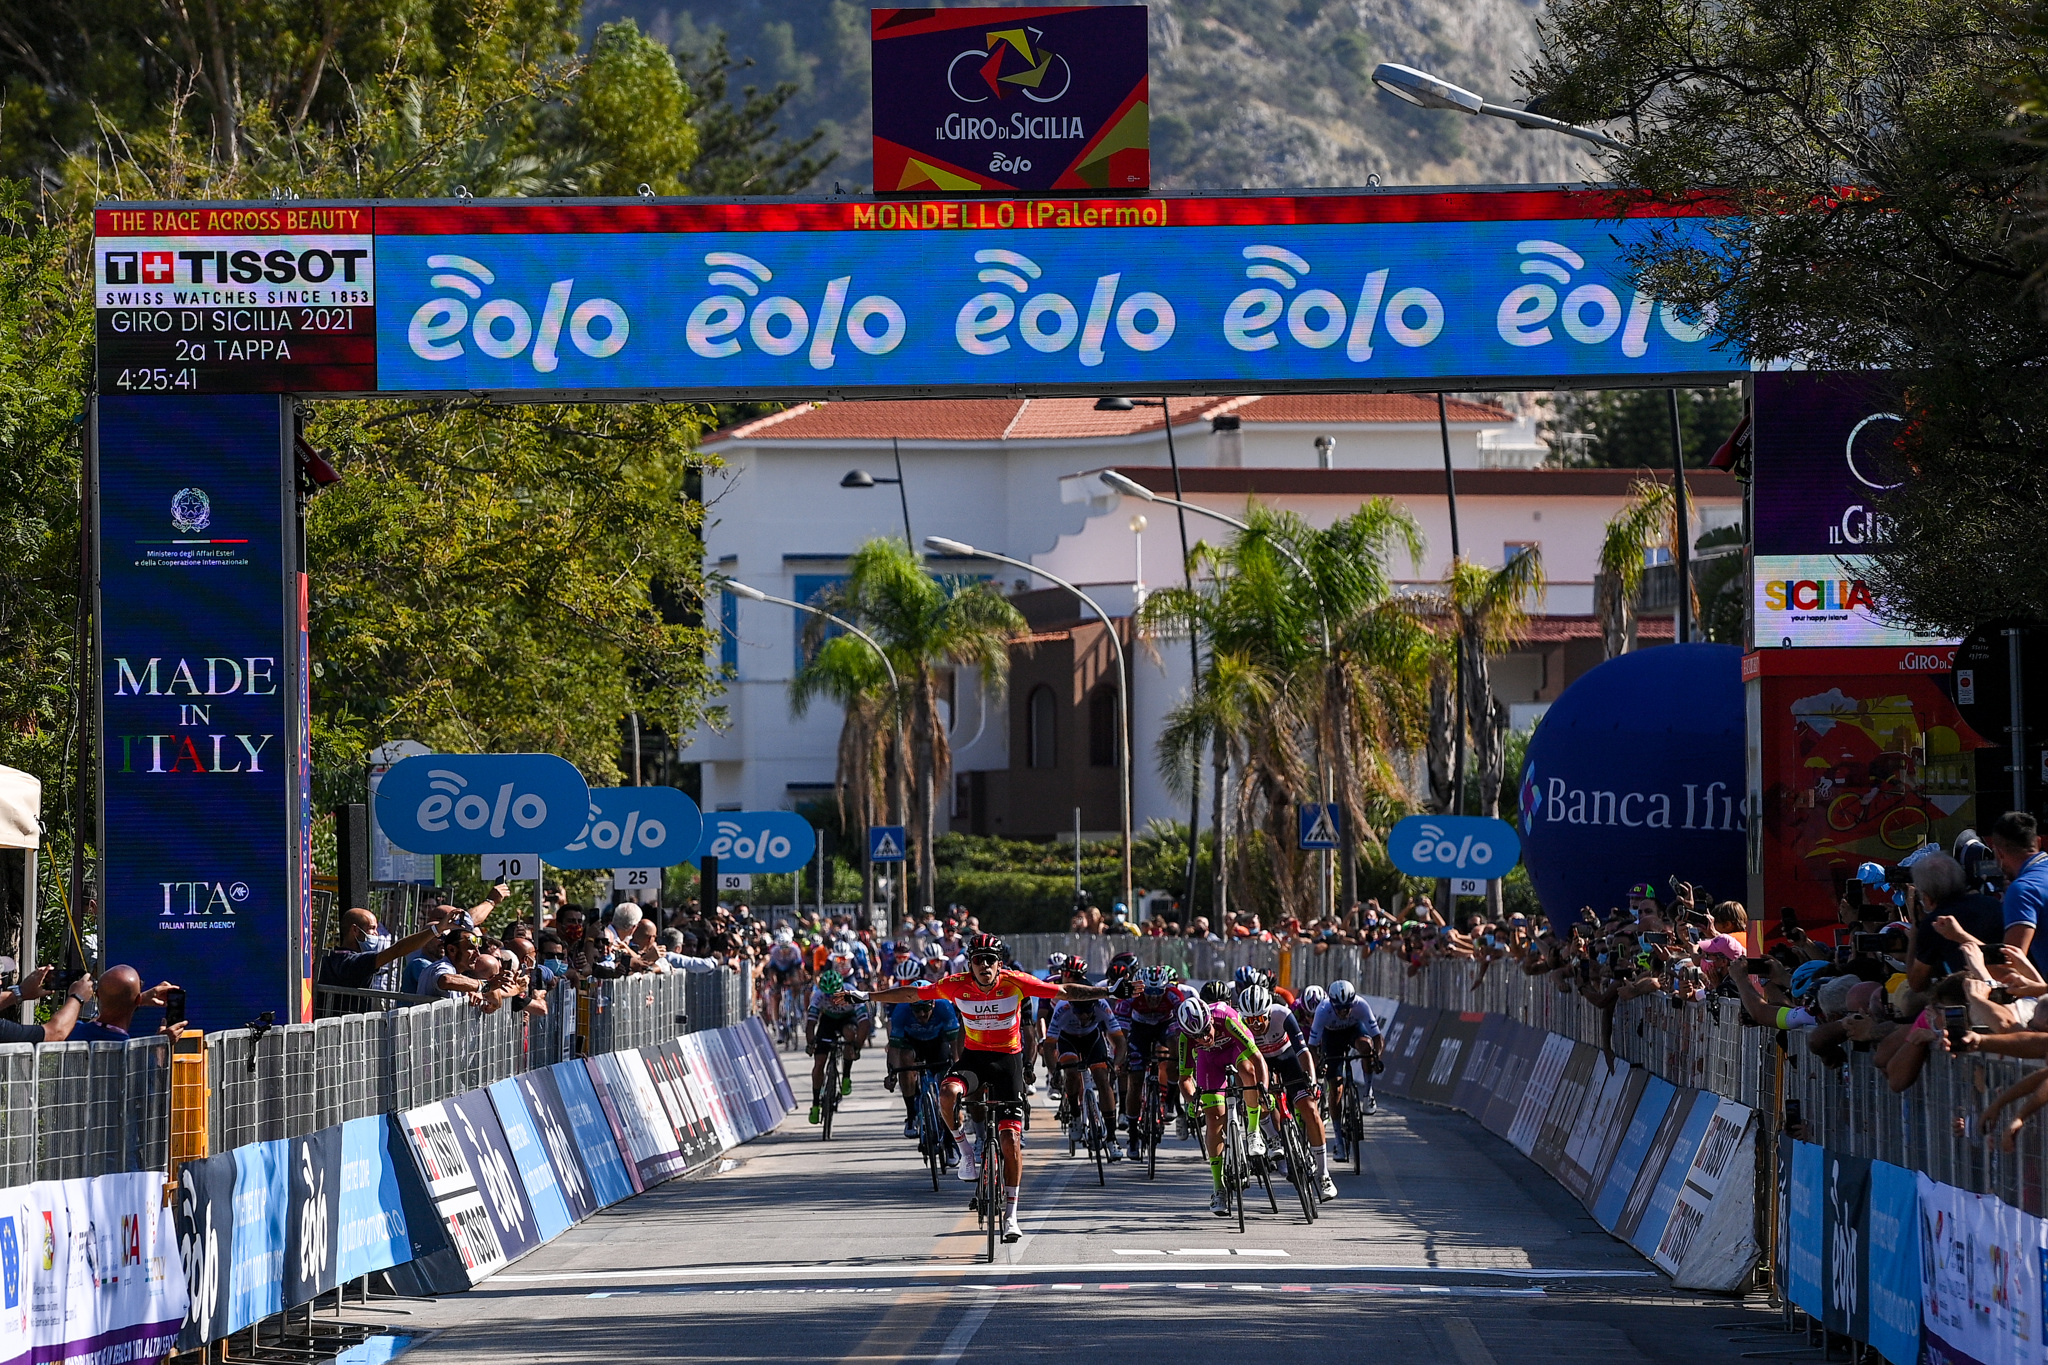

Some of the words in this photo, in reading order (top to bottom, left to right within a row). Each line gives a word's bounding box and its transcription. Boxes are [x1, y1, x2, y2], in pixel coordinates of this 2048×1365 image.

[936, 127, 945, 140] IL
[944, 113, 997, 140] GIRO
[999, 126, 1009, 139] DI
[1011, 112, 1085, 140] SICILIA
[989, 156, 1032, 174] eolo
[110, 212, 146, 232] THE
[153, 212, 200, 232] RACE
[208, 210, 281, 231] ACROSS
[287, 210, 360, 230] BEAUTY
[853, 203, 1015, 230] MONDELLO
[1025, 199, 1169, 228] (Palermo)
[179, 249, 368, 284] TISSOT
[106, 292, 164, 305] SWISS
[174, 291, 257, 304] WATCHES
[268, 290, 320, 304] SINCE
[331, 290, 369, 303] 1853
[1497, 268, 1720, 358] eolo
[111, 311, 173, 332] GIRO
[181, 311, 203, 332] DI
[212, 310, 292, 332] SICILIA
[300, 308, 353, 330] 2021
[408, 278, 630, 372] eolo
[686, 275, 907, 371] eolo
[955, 272, 1177, 367] eolo
[1223, 267, 1445, 363] eolo
[176, 339, 206, 362] 2a
[214, 339, 292, 361] TAPPA
[116, 368, 198, 390] 4:25:41
[1842, 505, 1898, 544] GIR
[179, 550, 194, 558] degli
[1765, 580, 1875, 611] SICILIA
[1806, 614, 1828, 622] happy
[114, 656, 276, 696] MADE
[1904, 652, 1939, 670] GIRO
[1940, 660, 1946, 669] DI
[180, 704, 210, 727] IN
[118, 734, 274, 774] ITALY
[417, 782, 547, 838] eolo
[1546, 778, 1672, 829] Banca
[711, 828, 790, 864] eolo
[1412, 834, 1492, 869] eolo
[498, 858, 521, 876] 10
[628, 871, 648, 884] 25
[725, 876, 740, 889] 50
[158, 882, 236, 916] ITA
[1460, 880, 1476, 892] 50
[158, 922, 184, 930] ITALIAN
[186, 922, 208, 930] TRADE
[209, 922, 236, 930] AGENCY
[974, 1004, 999, 1014] UAE
[421, 1120, 468, 1179] TISSOT
[1699, 1118, 1742, 1180] TISSOT
[478, 1126, 525, 1243] eolo
[301, 1168, 328, 1294] eolo
[456, 1205, 500, 1267] TISSOT
[1832, 1200, 1858, 1335] eolo
